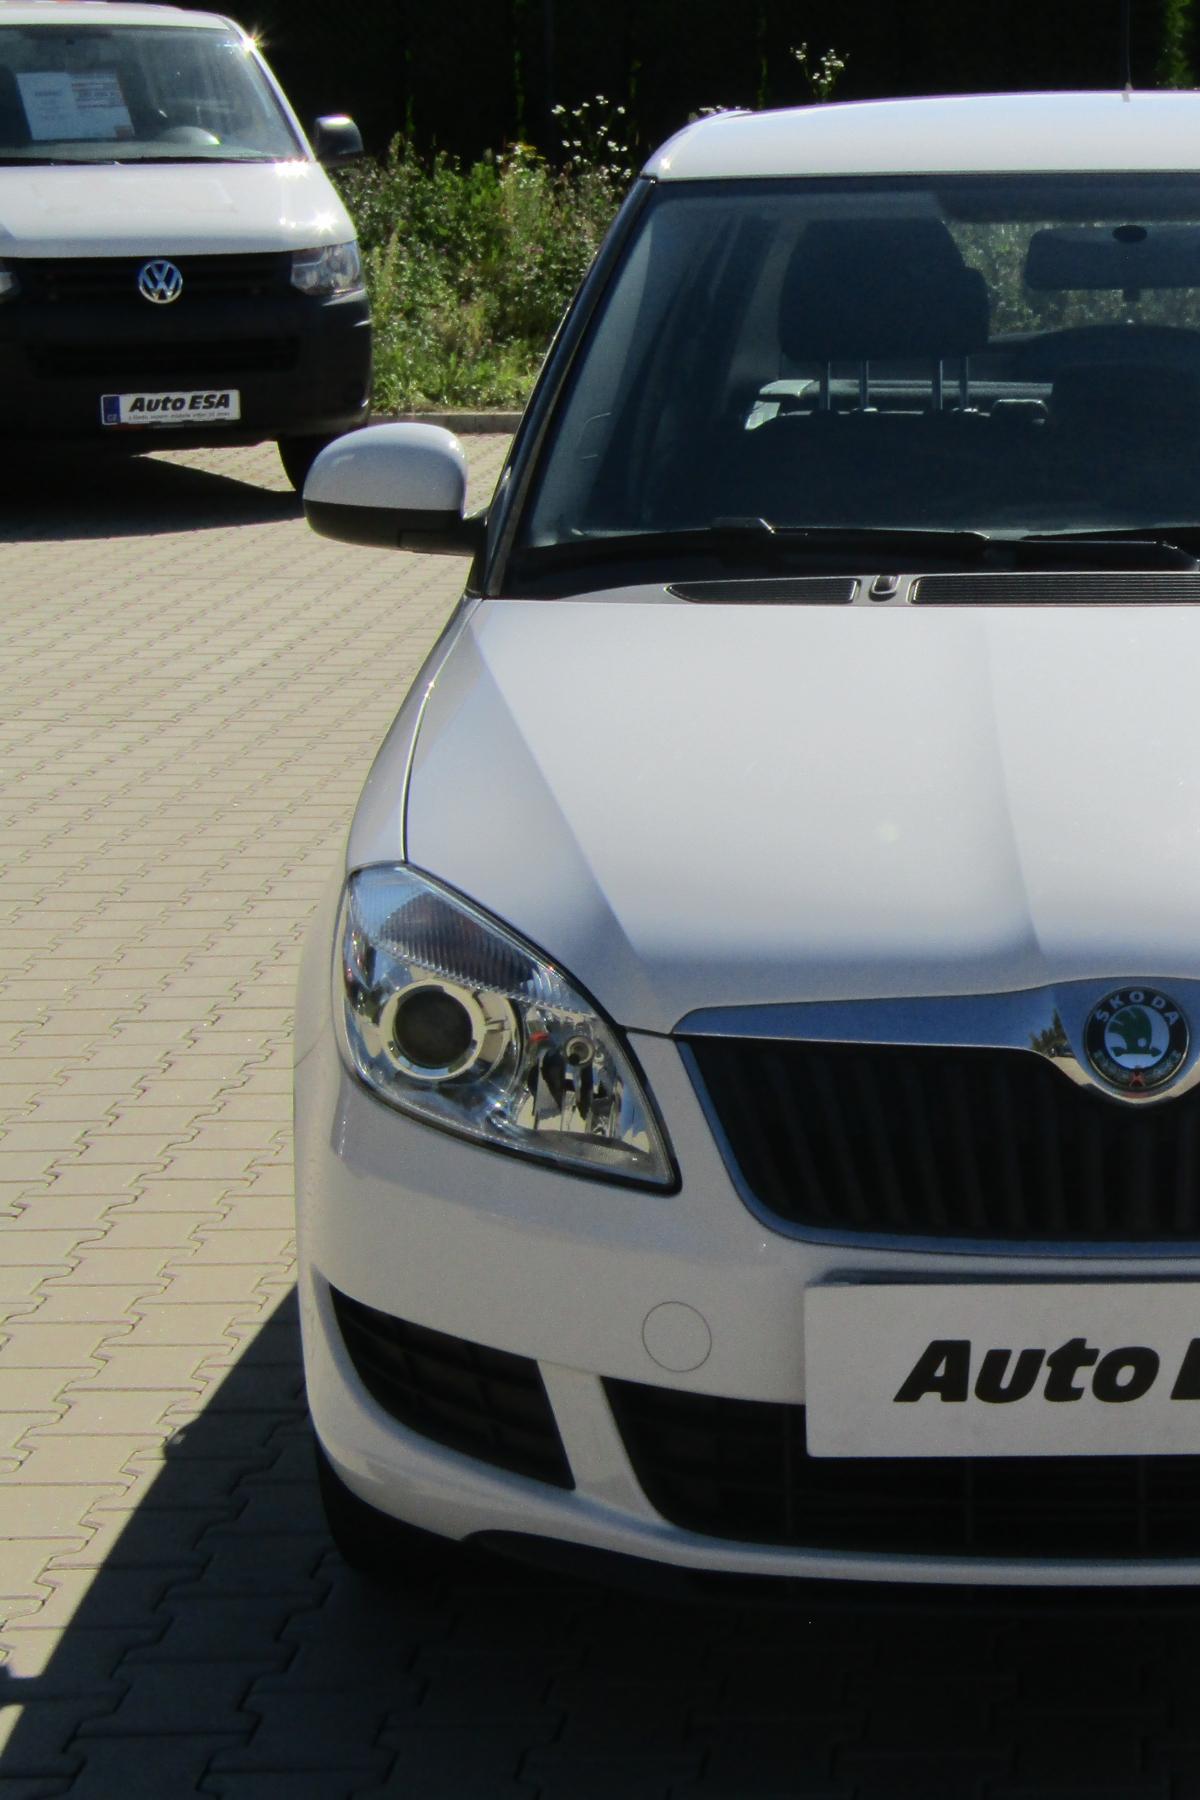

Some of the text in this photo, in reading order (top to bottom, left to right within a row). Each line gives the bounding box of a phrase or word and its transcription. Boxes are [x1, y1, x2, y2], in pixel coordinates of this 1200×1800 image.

[128, 394, 230, 412] Auto ESA
[892, 1337, 1160, 1404] Auto
